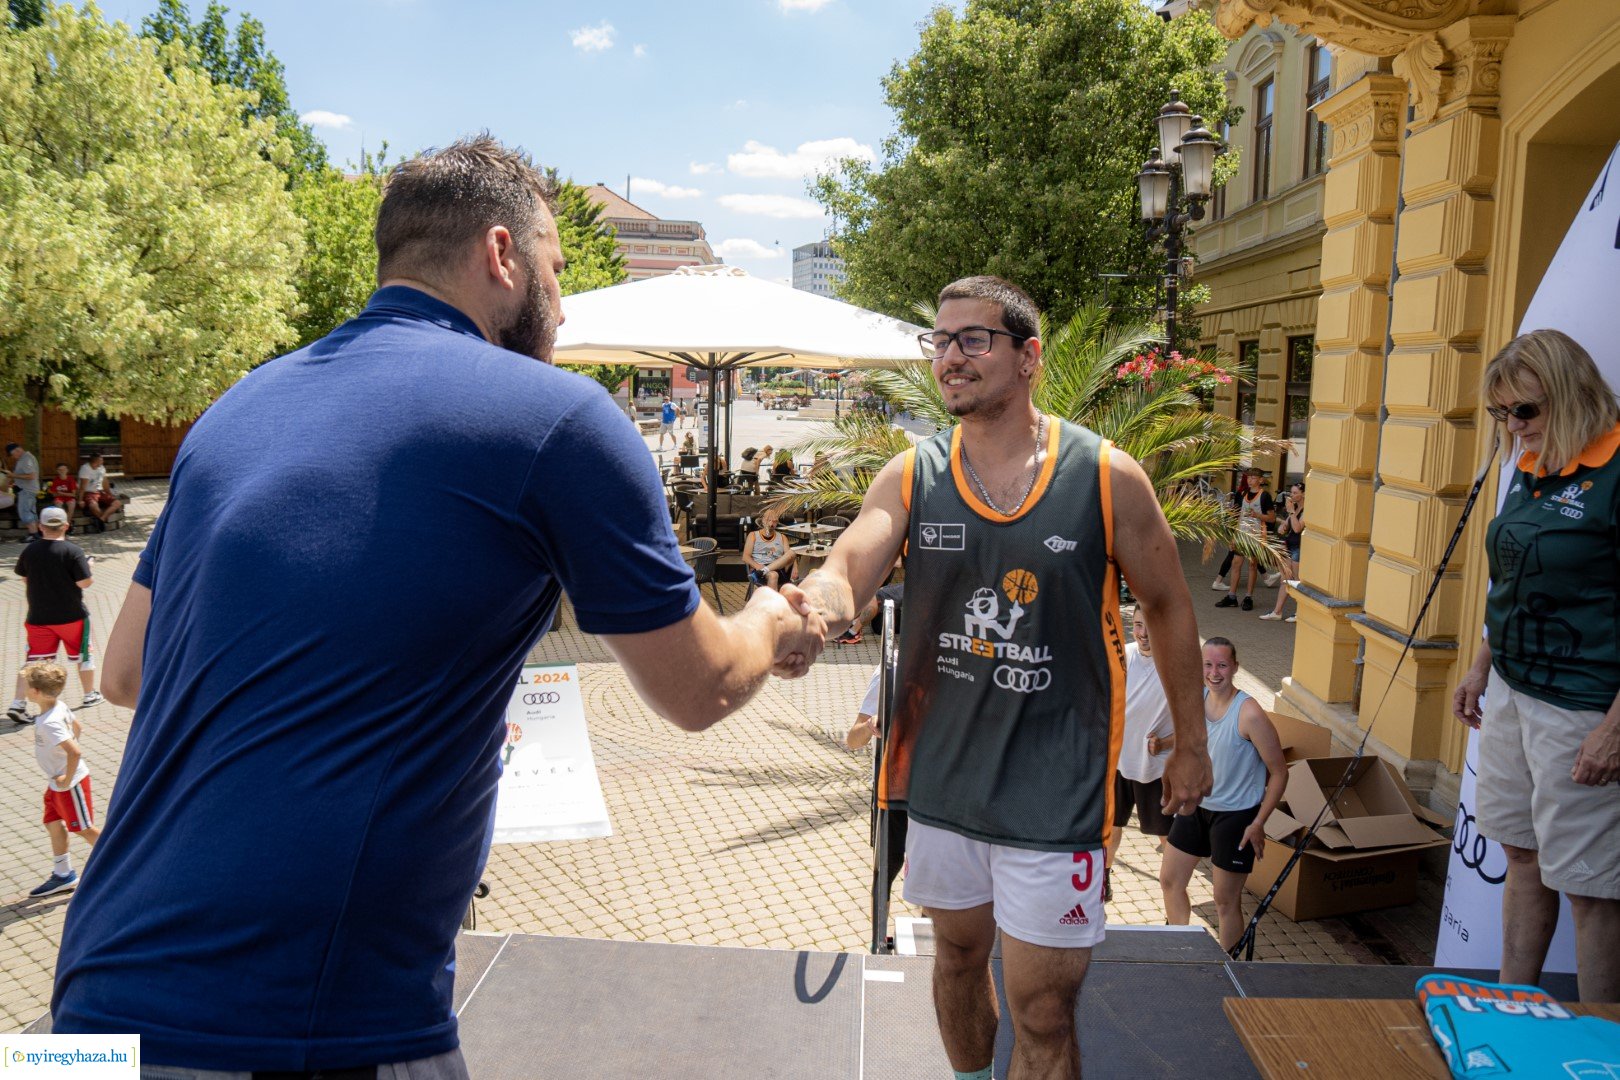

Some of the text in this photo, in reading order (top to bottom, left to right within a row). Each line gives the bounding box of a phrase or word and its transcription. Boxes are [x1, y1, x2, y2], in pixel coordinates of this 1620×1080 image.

[938, 632, 1053, 664] STREETBALL
[937, 655, 959, 666] Audi
[533, 671, 570, 684] 2024
[937, 665, 975, 682] Hungaria
[1059, 917, 1089, 925] adidas
